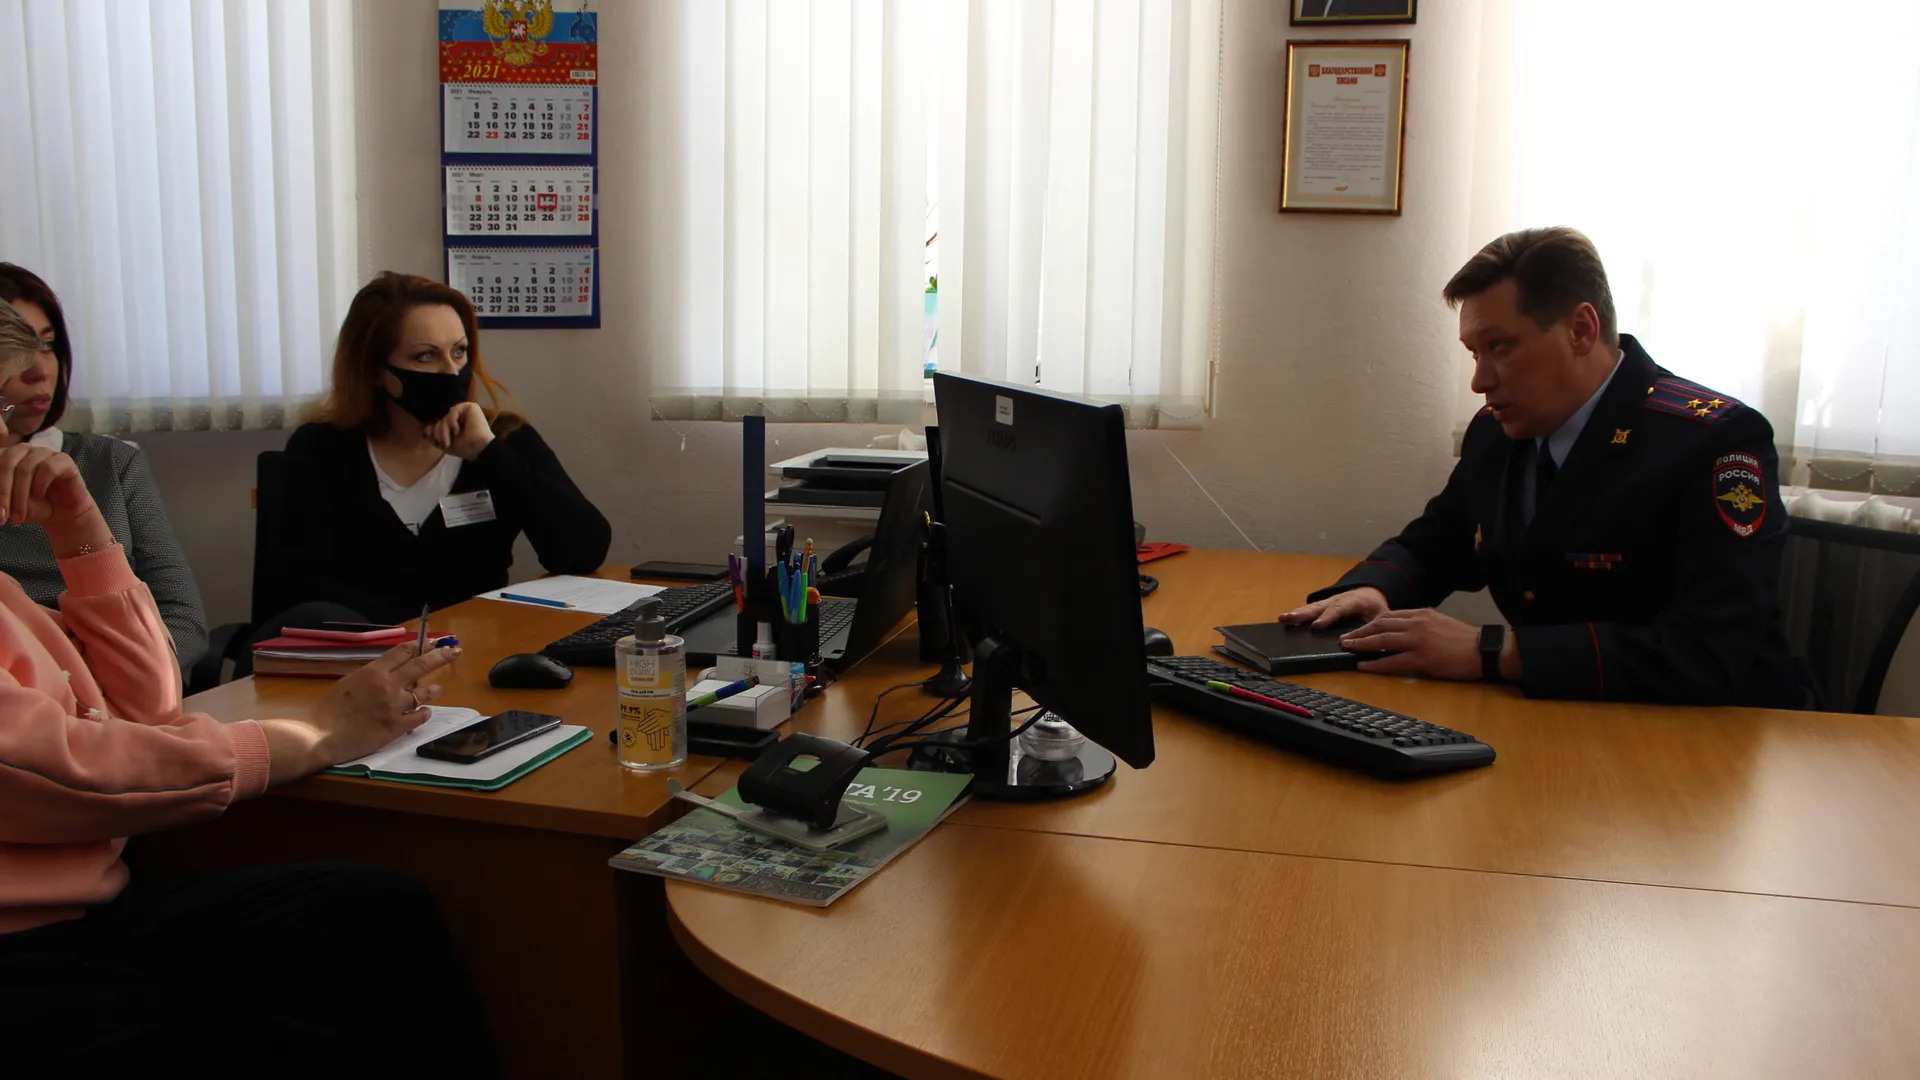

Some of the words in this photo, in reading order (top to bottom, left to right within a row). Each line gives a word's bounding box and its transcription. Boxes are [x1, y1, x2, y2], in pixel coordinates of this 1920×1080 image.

[463, 64, 500, 78] 2021
[474, 102, 479, 110] 1
[492, 102, 498, 110] 2
[510, 102, 517, 110] 3
[528, 103, 535, 111] 4
[546, 103, 554, 111] 5
[565, 103, 572, 112] 6
[584, 104, 590, 112] 7
[473, 111, 480, 120] 8
[492, 111, 499, 120] 9
[504, 112, 517, 120] 10
[523, 112, 534, 120] 11
[541, 112, 553, 121] 12
[560, 113, 572, 121] 13
[577, 113, 590, 121] 14
[468, 121, 480, 129] 15
[486, 121, 499, 130] 16
[504, 121, 517, 130] 17
[523, 122, 535, 130] 18
[541, 122, 553, 130] 19
[559, 122, 572, 130] 20
[576, 123, 588, 131] 21
[467, 130, 480, 139] 22
[486, 131, 499, 139] 23
[504, 131, 517, 139] 24
[522, 131, 535, 140] 25
[540, 132, 553, 140] 26
[559, 132, 571, 140] 27
[576, 132, 590, 140] 28
[476, 185, 481, 193] 1
[493, 185, 500, 193] 2
[511, 185, 518, 193] 3
[529, 185, 536, 193] 4
[547, 185, 554, 193] 5
[565, 185, 572, 193] 6
[584, 185, 590, 193] 7
[475, 194, 482, 202] 8
[493, 194, 500, 202] 9
[505, 194, 518, 202] 10
[524, 194, 535, 202] 11
[542, 194, 554, 202] 12
[560, 194, 572, 203] 13
[578, 194, 590, 203] 14
[470, 204, 482, 212] 15
[488, 204, 500, 212] 16
[506, 204, 518, 212] 17
[524, 204, 537, 212] 18
[578, 204, 589, 212] 21
[469, 213, 482, 222] 22
[487, 213, 500, 222] 23
[505, 213, 518, 221] 24
[523, 213, 536, 222] 25
[542, 213, 554, 222] 26
[560, 213, 572, 222] 27
[577, 213, 590, 221] 28
[469, 223, 482, 231] 29
[487, 223, 500, 231] 30
[505, 223, 517, 231] 31
[531, 267, 536, 275] 1
[549, 267, 556, 275] 2
[567, 267, 574, 275] 3
[584, 267, 590, 275] 4
[477, 276, 484, 284] 5
[495, 276, 502, 284] 6
[513, 276, 520, 284] 7
[531, 276, 538, 285] 8
[549, 276, 556, 284] 9
[561, 276, 574, 284] 10
[579, 276, 589, 284] 11
[471, 286, 484, 294] 12
[490, 286, 502, 294] 13
[507, 286, 520, 294] 14
[525, 286, 538, 294] 15
[543, 286, 556, 294] 16
[561, 286, 573, 294] 17
[579, 285, 589, 293] 18
[471, 296, 484, 304] 19
[489, 295, 502, 304] 20
[507, 295, 519, 303] 21
[525, 295, 538, 304] 22
[543, 295, 556, 303] 23
[561, 295, 573, 303] 24
[577, 294, 589, 303] 25
[489, 305, 502, 313] 27
[507, 305, 520, 313] 28
[525, 305, 538, 313] 29
[543, 305, 556, 313] 30
[1716, 454, 1759, 469] ПОЛИЦИЯ
[1718, 469, 1760, 486] РОССИЯ
[1733, 523, 1754, 536] МВД
[630, 659, 655, 669] HIGH
[630, 668, 655, 678] purity
